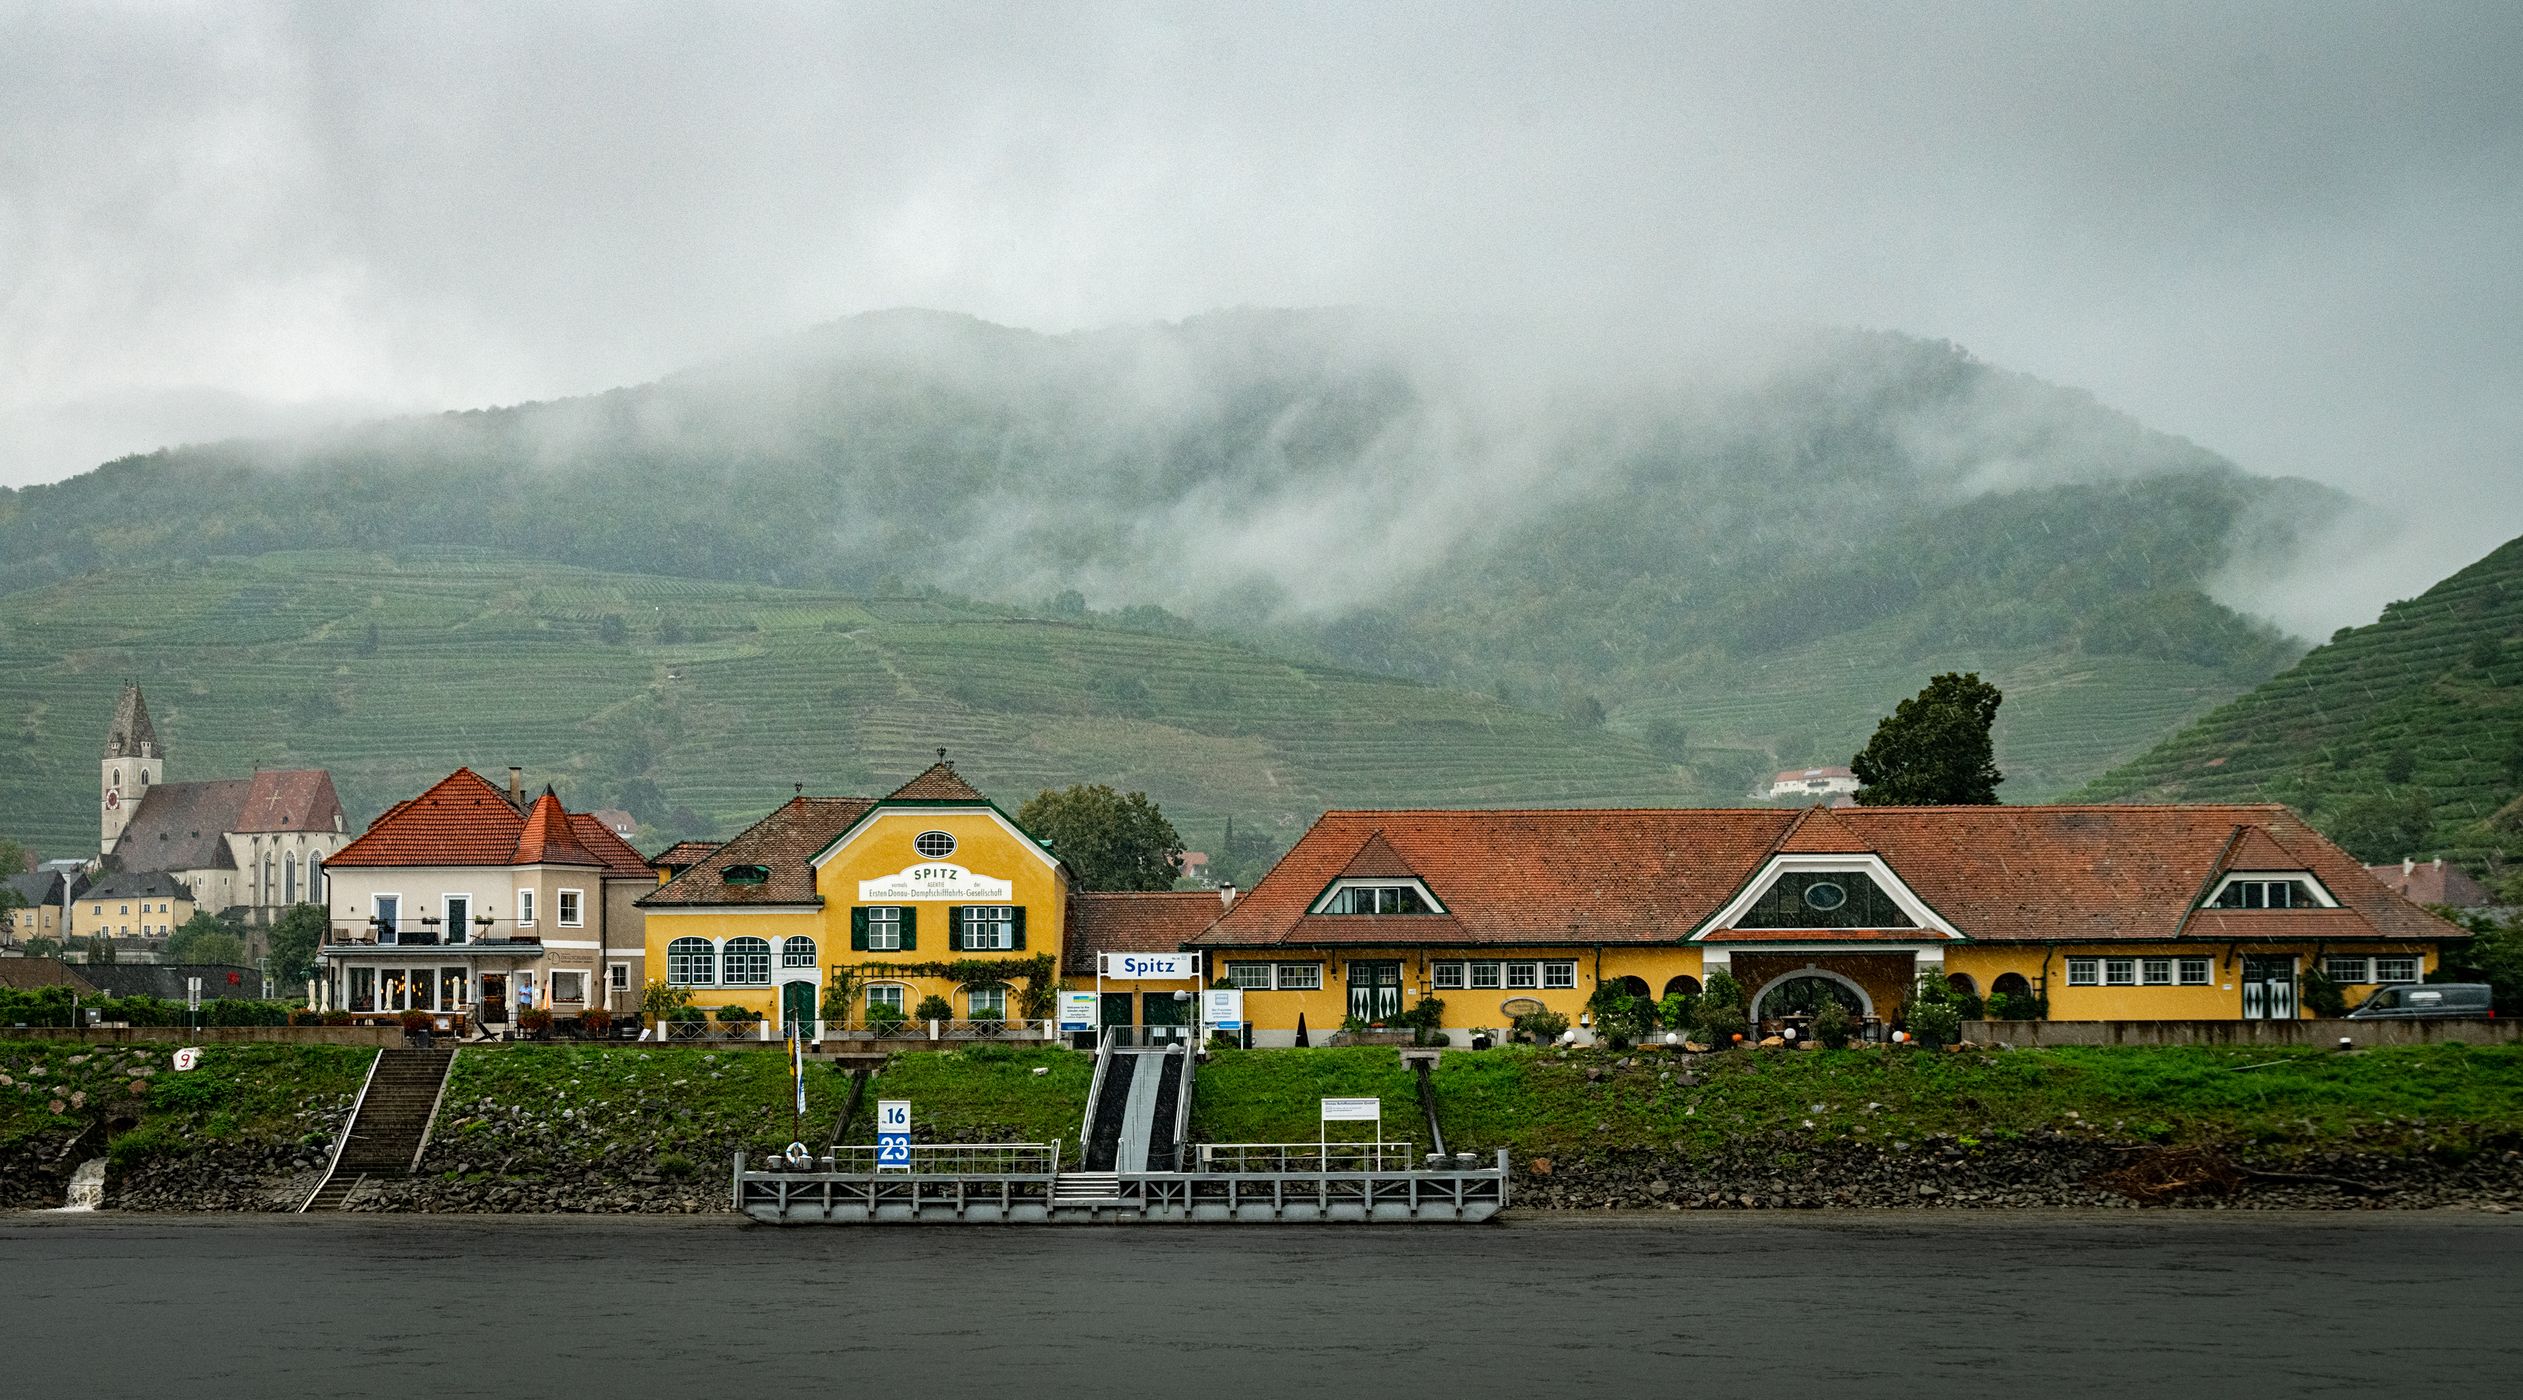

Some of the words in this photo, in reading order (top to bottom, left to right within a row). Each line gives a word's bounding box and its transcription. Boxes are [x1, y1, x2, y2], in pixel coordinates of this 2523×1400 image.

[914, 868, 958, 880] SPITZ
[869, 888, 888, 897] Ersten
[1124, 957, 1175, 976] Spitz
[180, 1053, 191, 1068] 9
[887, 1107, 906, 1124] 16
[880, 1136, 909, 1160] 23
